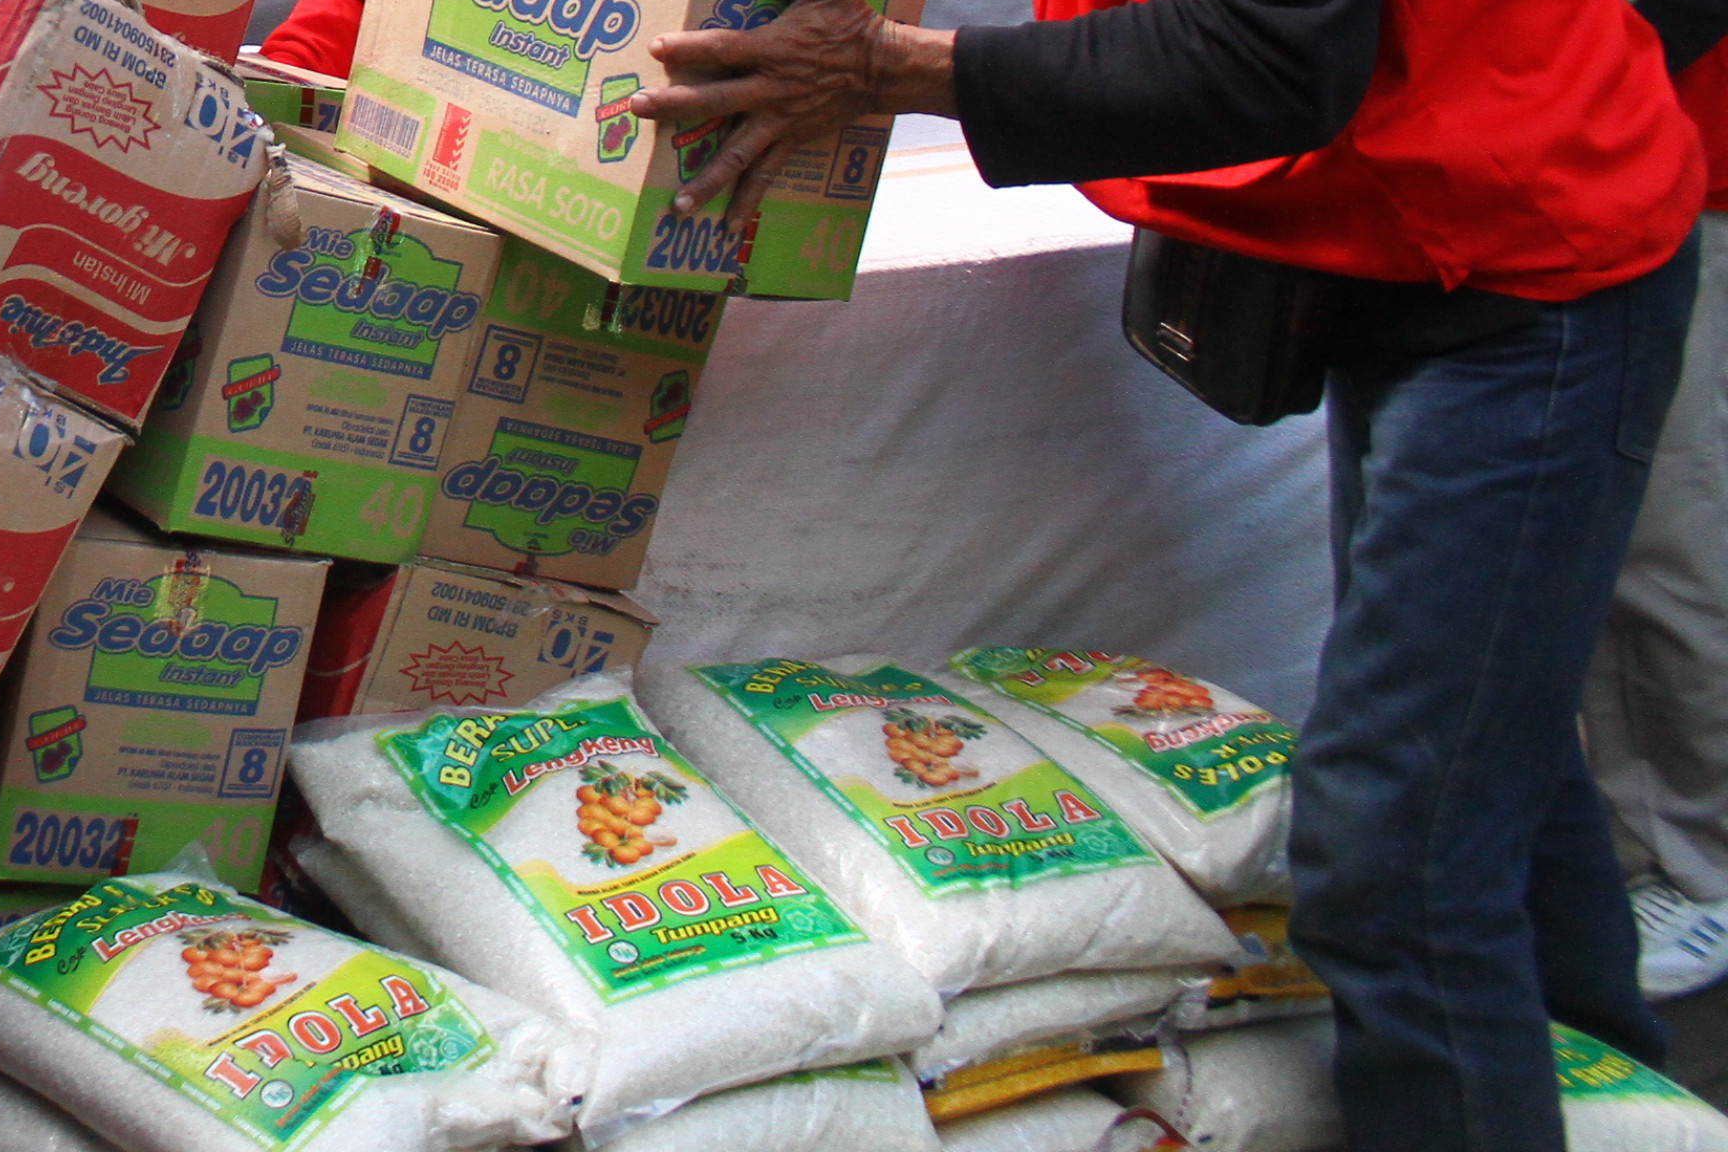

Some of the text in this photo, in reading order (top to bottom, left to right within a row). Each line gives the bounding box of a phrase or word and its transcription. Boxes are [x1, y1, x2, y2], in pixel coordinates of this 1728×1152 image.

[73, 25, 168, 90] BPOM RI MD
[488, 19, 572, 70] Instant
[429, 44, 463, 69] JELAS
[464, 54, 508, 87] TERASA
[509, 71, 572, 112] SEDAPNYA
[842, 147, 868, 185] 8
[15, 151, 150, 240] goreng
[483, 156, 623, 242] RASA SOTO
[302, 225, 355, 259] Mie
[646, 212, 748, 275] 20032
[799, 214, 859, 273] 40
[72, 248, 153, 306] Mi Instan
[255, 248, 482, 342] Sedaap
[504, 259, 570, 320] 40
[291, 341, 424, 376] JELAS TERASA SEDAPNYA
[350, 318, 425, 350] Instant
[493, 343, 522, 382] 8
[408, 416, 437, 455] 8
[506, 448, 580, 476] Instant
[194, 460, 307, 530] 20032
[358, 481, 425, 540] 40
[441, 454, 660, 538] Sedaap
[568, 528, 620, 557] Mie
[90, 577, 156, 608] Mie
[551, 608, 589, 627] BKS
[48, 598, 304, 678] Sedaap
[426, 604, 519, 640] BPOM RI MD
[94, 691, 249, 714] JELAS TERASA SEDAPNYA
[159, 662, 245, 689] Instant
[238, 748, 267, 784] 8
[501, 735, 660, 797] Lengkeng
[9, 811, 127, 870] 20032
[199, 814, 263, 869] 40
[883, 788, 1105, 849] IDOLA
[963, 831, 1076, 858] Tumpang
[565, 863, 811, 945] IDOLA
[651, 906, 779, 945] Tumpang
[750, 926, 780, 942] Kg
[204, 973, 431, 1101] IDOLA
